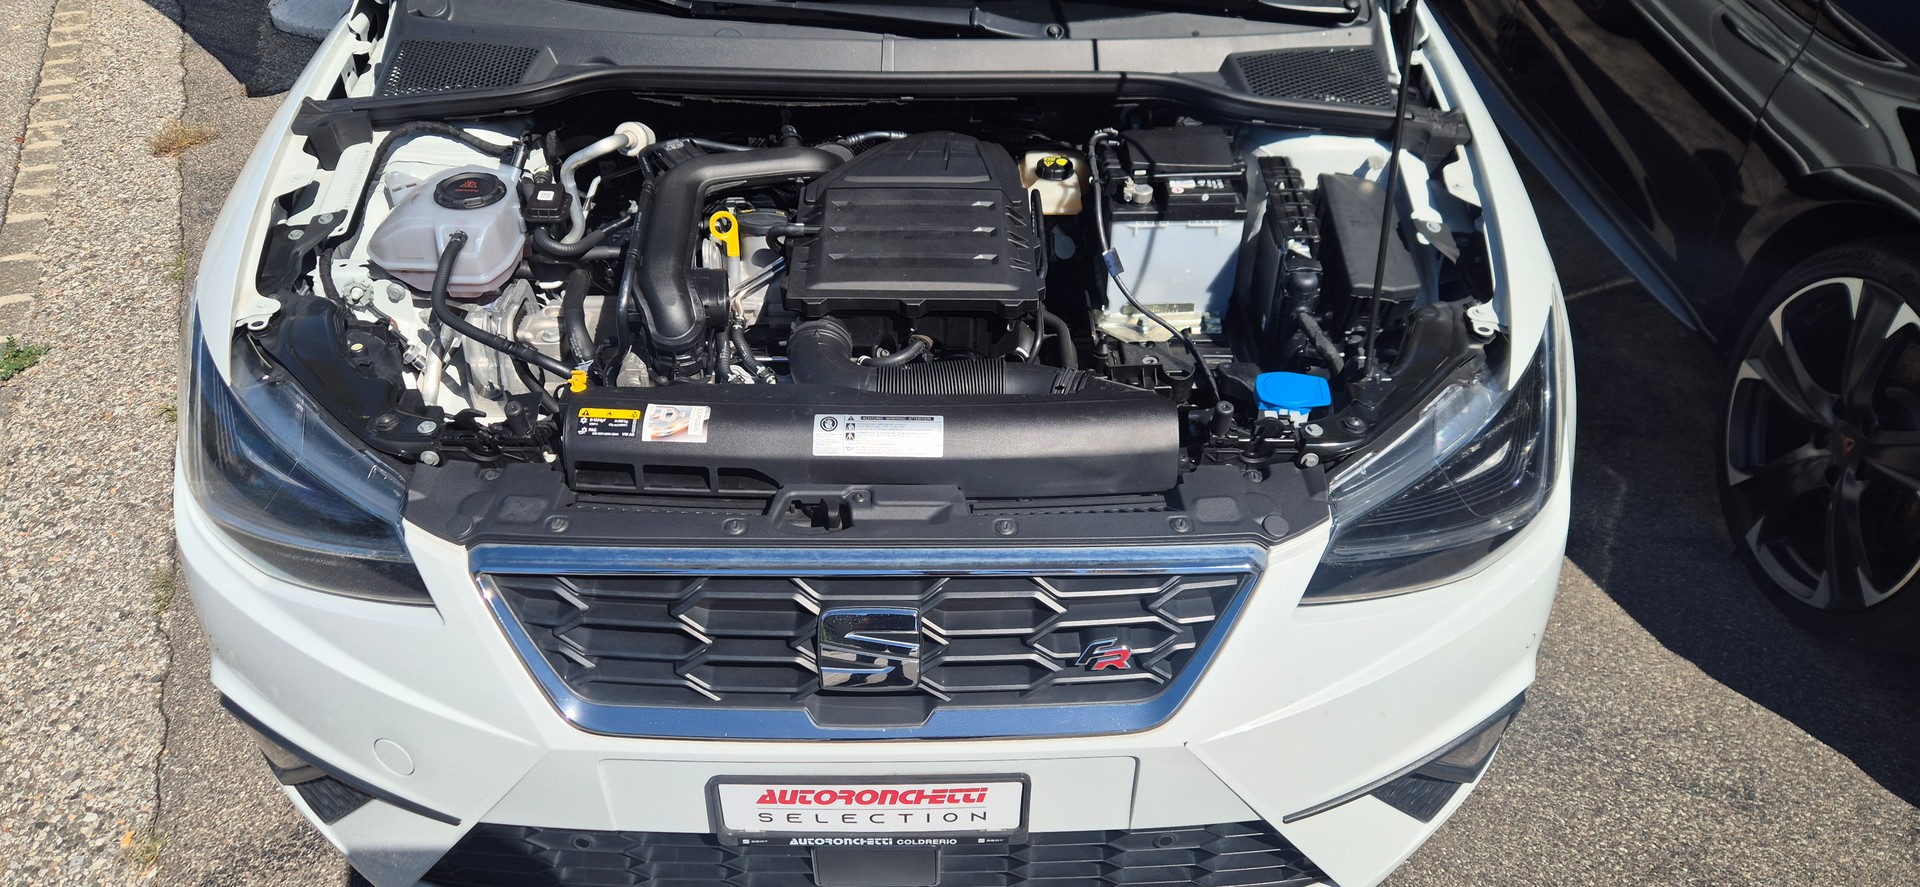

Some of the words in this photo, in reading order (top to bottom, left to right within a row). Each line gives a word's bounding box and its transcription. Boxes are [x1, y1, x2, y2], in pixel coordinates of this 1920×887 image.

[1075, 637, 1131, 670] FR
[756, 788, 988, 805] AUTORONCHETTI
[758, 812, 987, 824] SELECTION
